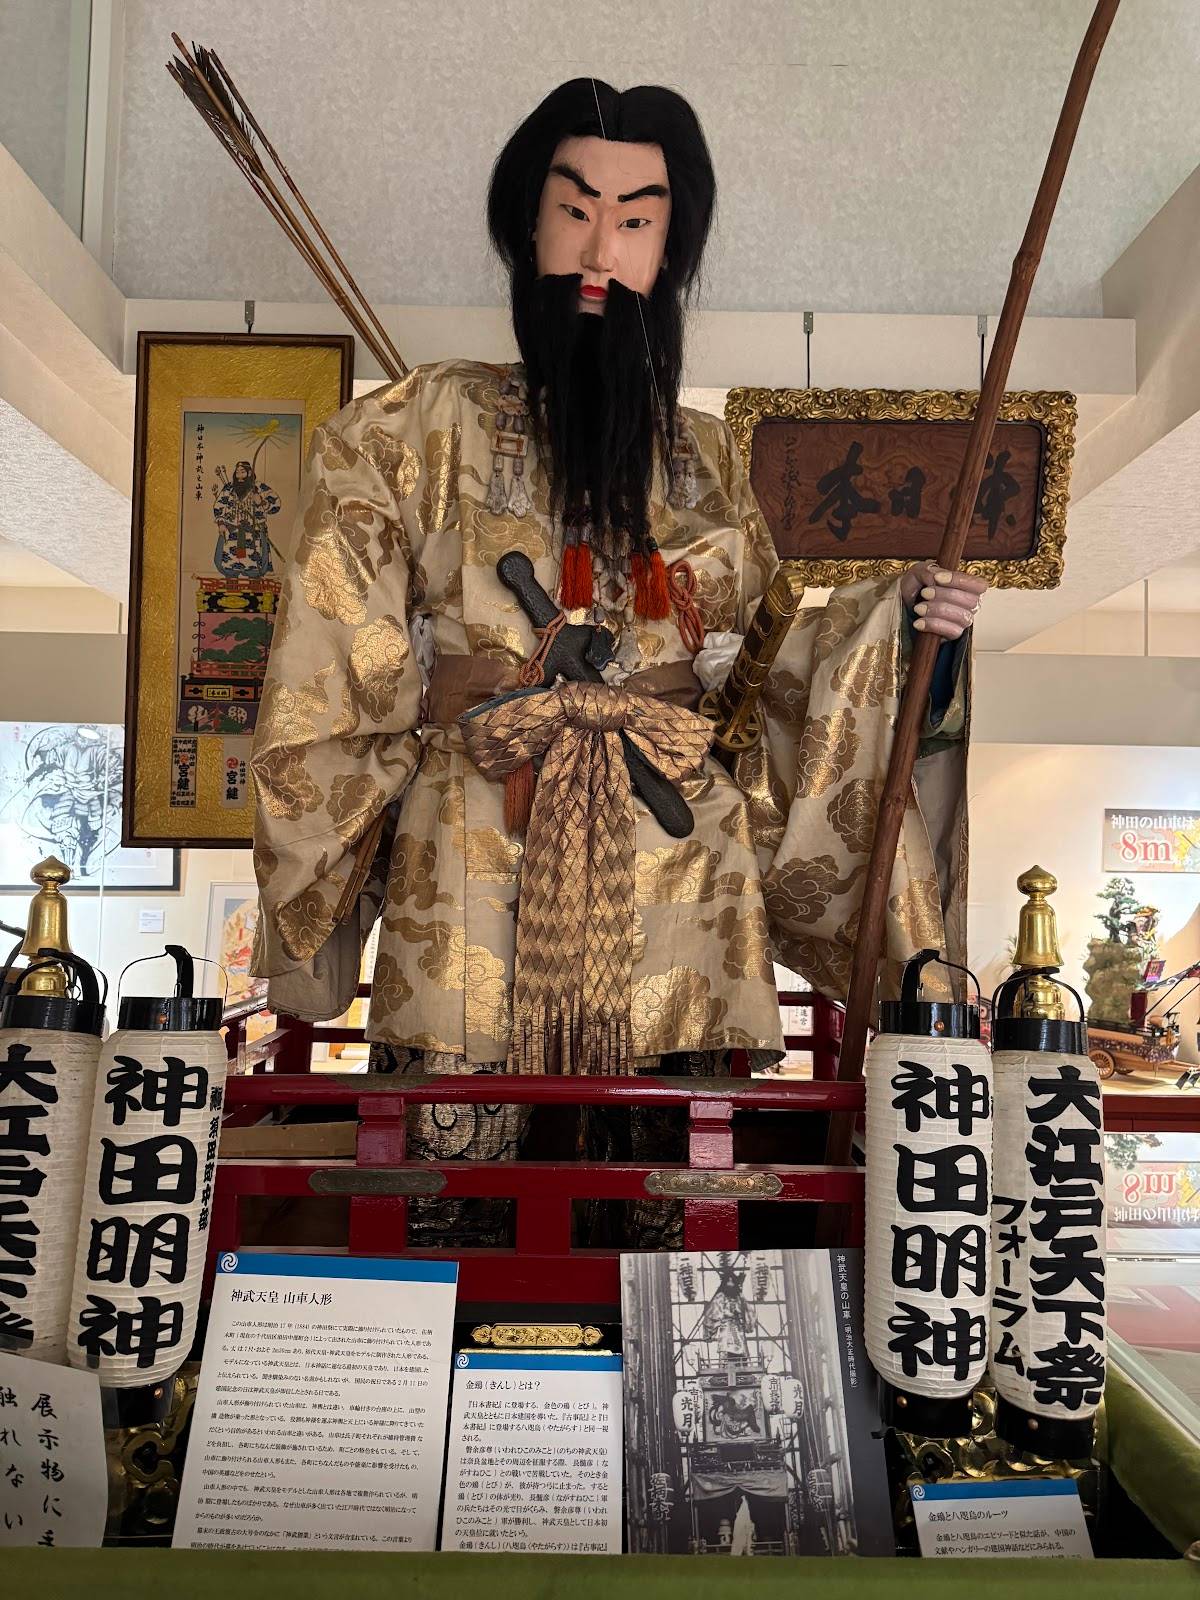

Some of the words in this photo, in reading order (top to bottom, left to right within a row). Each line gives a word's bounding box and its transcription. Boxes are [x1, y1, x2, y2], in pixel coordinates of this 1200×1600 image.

[1121, 831, 1172, 862] 8m
[78, 1056, 209, 1369] 神田明神
[231, 1289, 279, 1304] 神武天皇
[283, 1290, 333, 1306] 山車人形
[837, 1254, 852, 1319] 神武天皇の山車
[887, 1060, 990, 1381] 神田明神
[992, 1195, 1028, 1377] フォーラム
[1024, 1064, 1106, 1411] 大江戸天下祭
